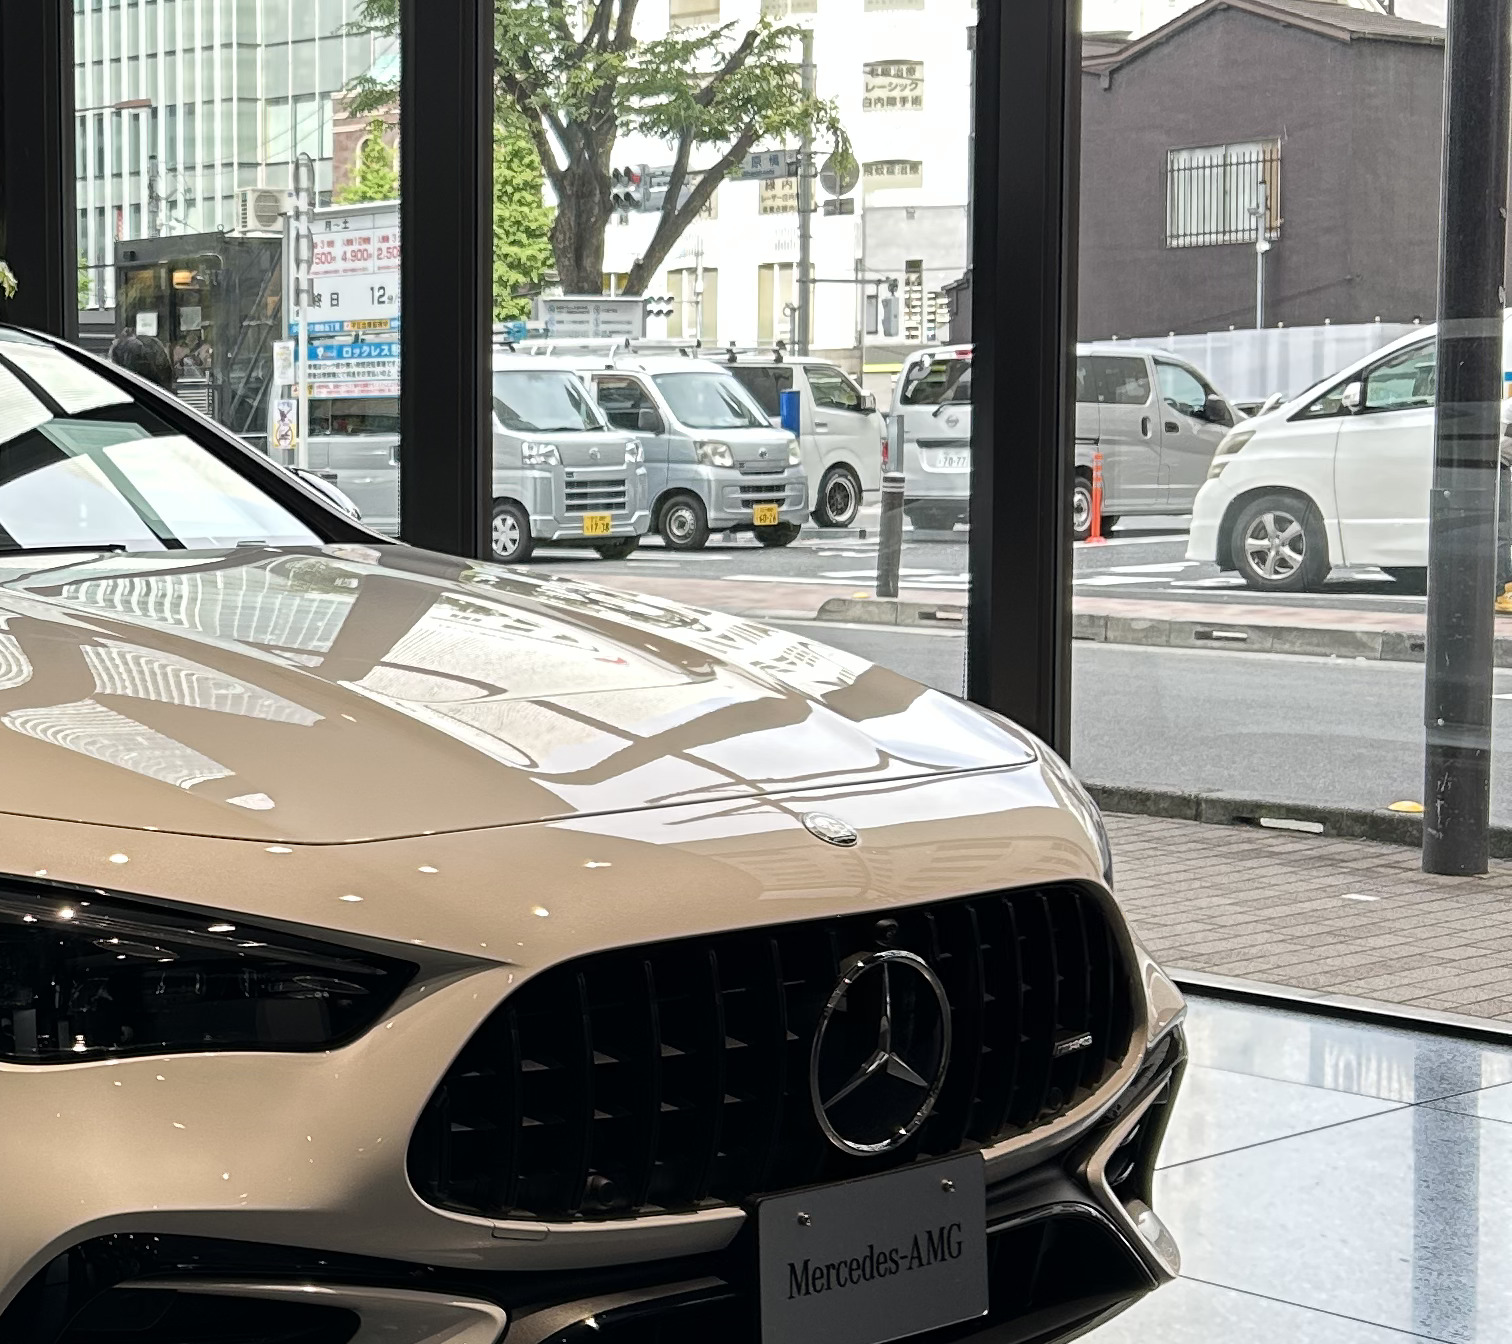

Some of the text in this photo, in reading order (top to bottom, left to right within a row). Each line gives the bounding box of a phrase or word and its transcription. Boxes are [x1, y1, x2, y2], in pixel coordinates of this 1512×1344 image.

[865, 81, 919, 93] レーシック
[787, 1222, 964, 1300] Mercedes-AMG
